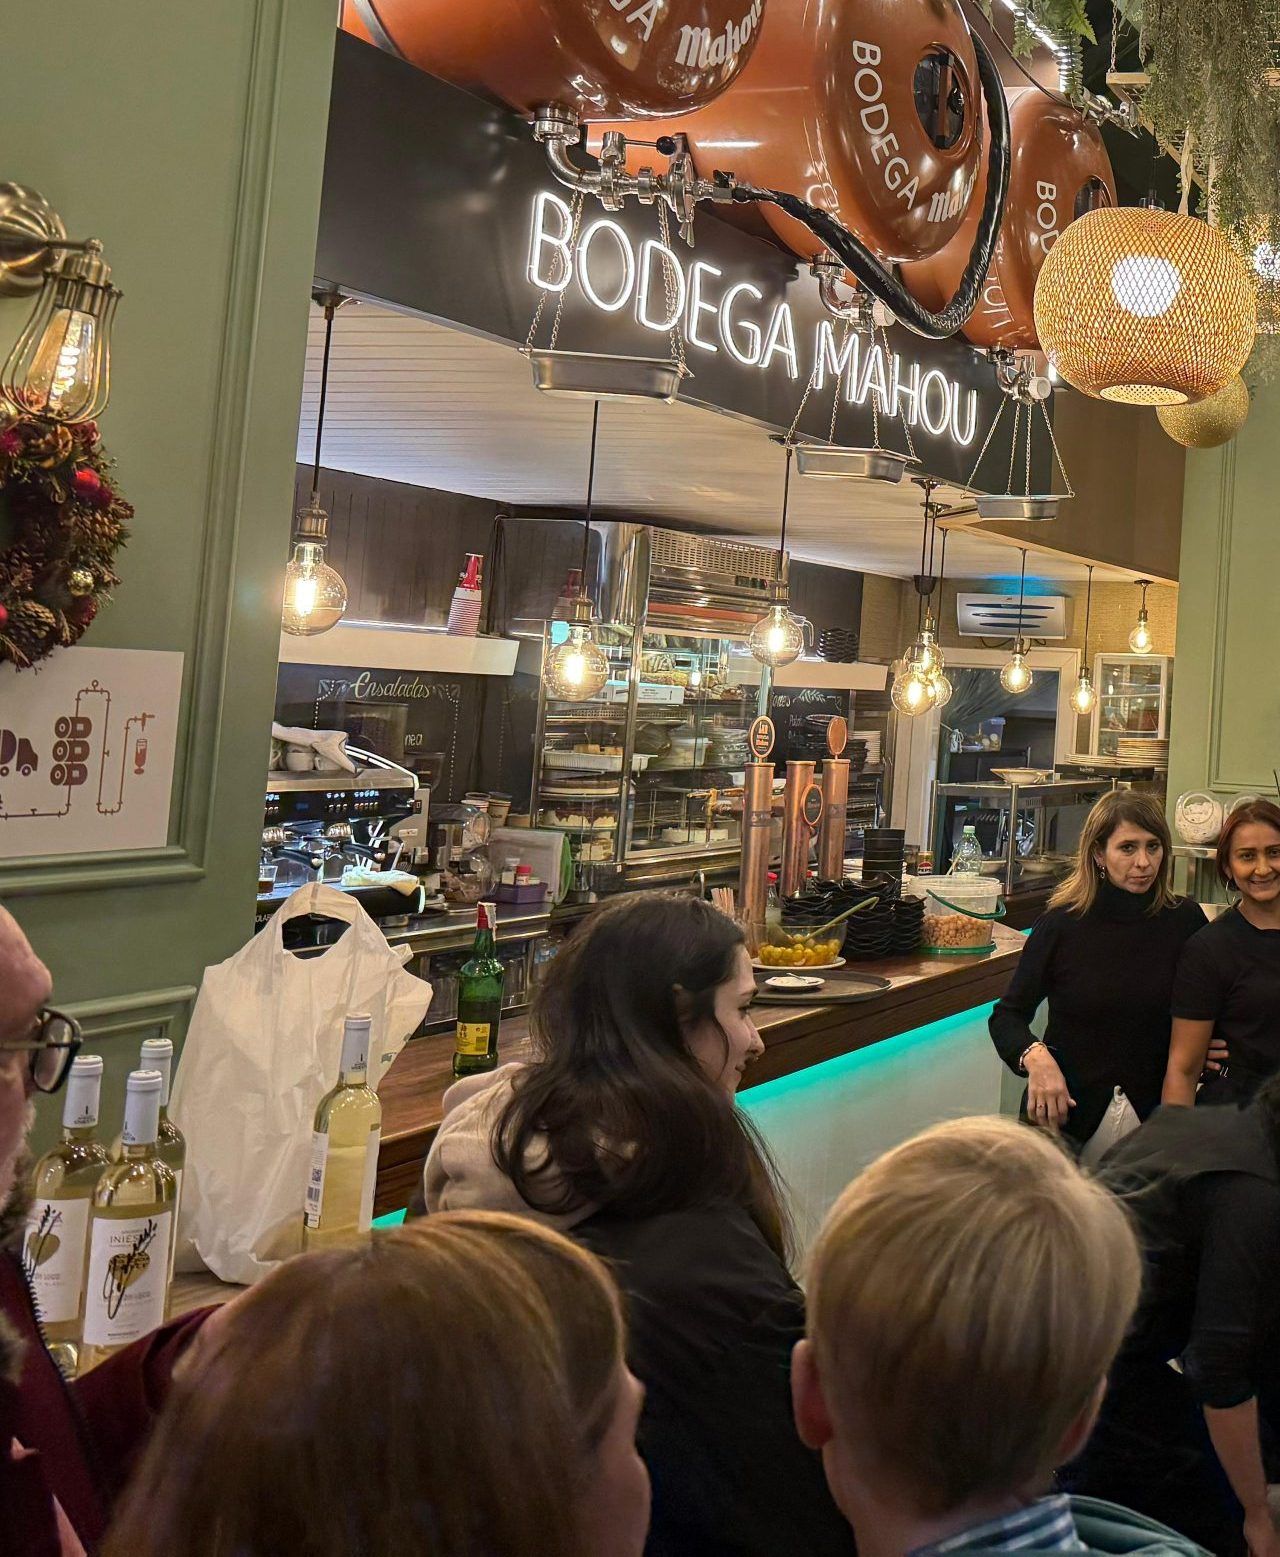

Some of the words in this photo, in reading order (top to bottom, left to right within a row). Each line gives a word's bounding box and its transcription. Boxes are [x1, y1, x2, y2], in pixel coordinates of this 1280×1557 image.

[852, 40, 920, 210] BODEGA
[1036, 180, 1060, 255] BOD
[527, 191, 798, 379] BODEGA
[815, 320, 977, 446] MAHOU
[352, 671, 430, 698] Ensaladas
